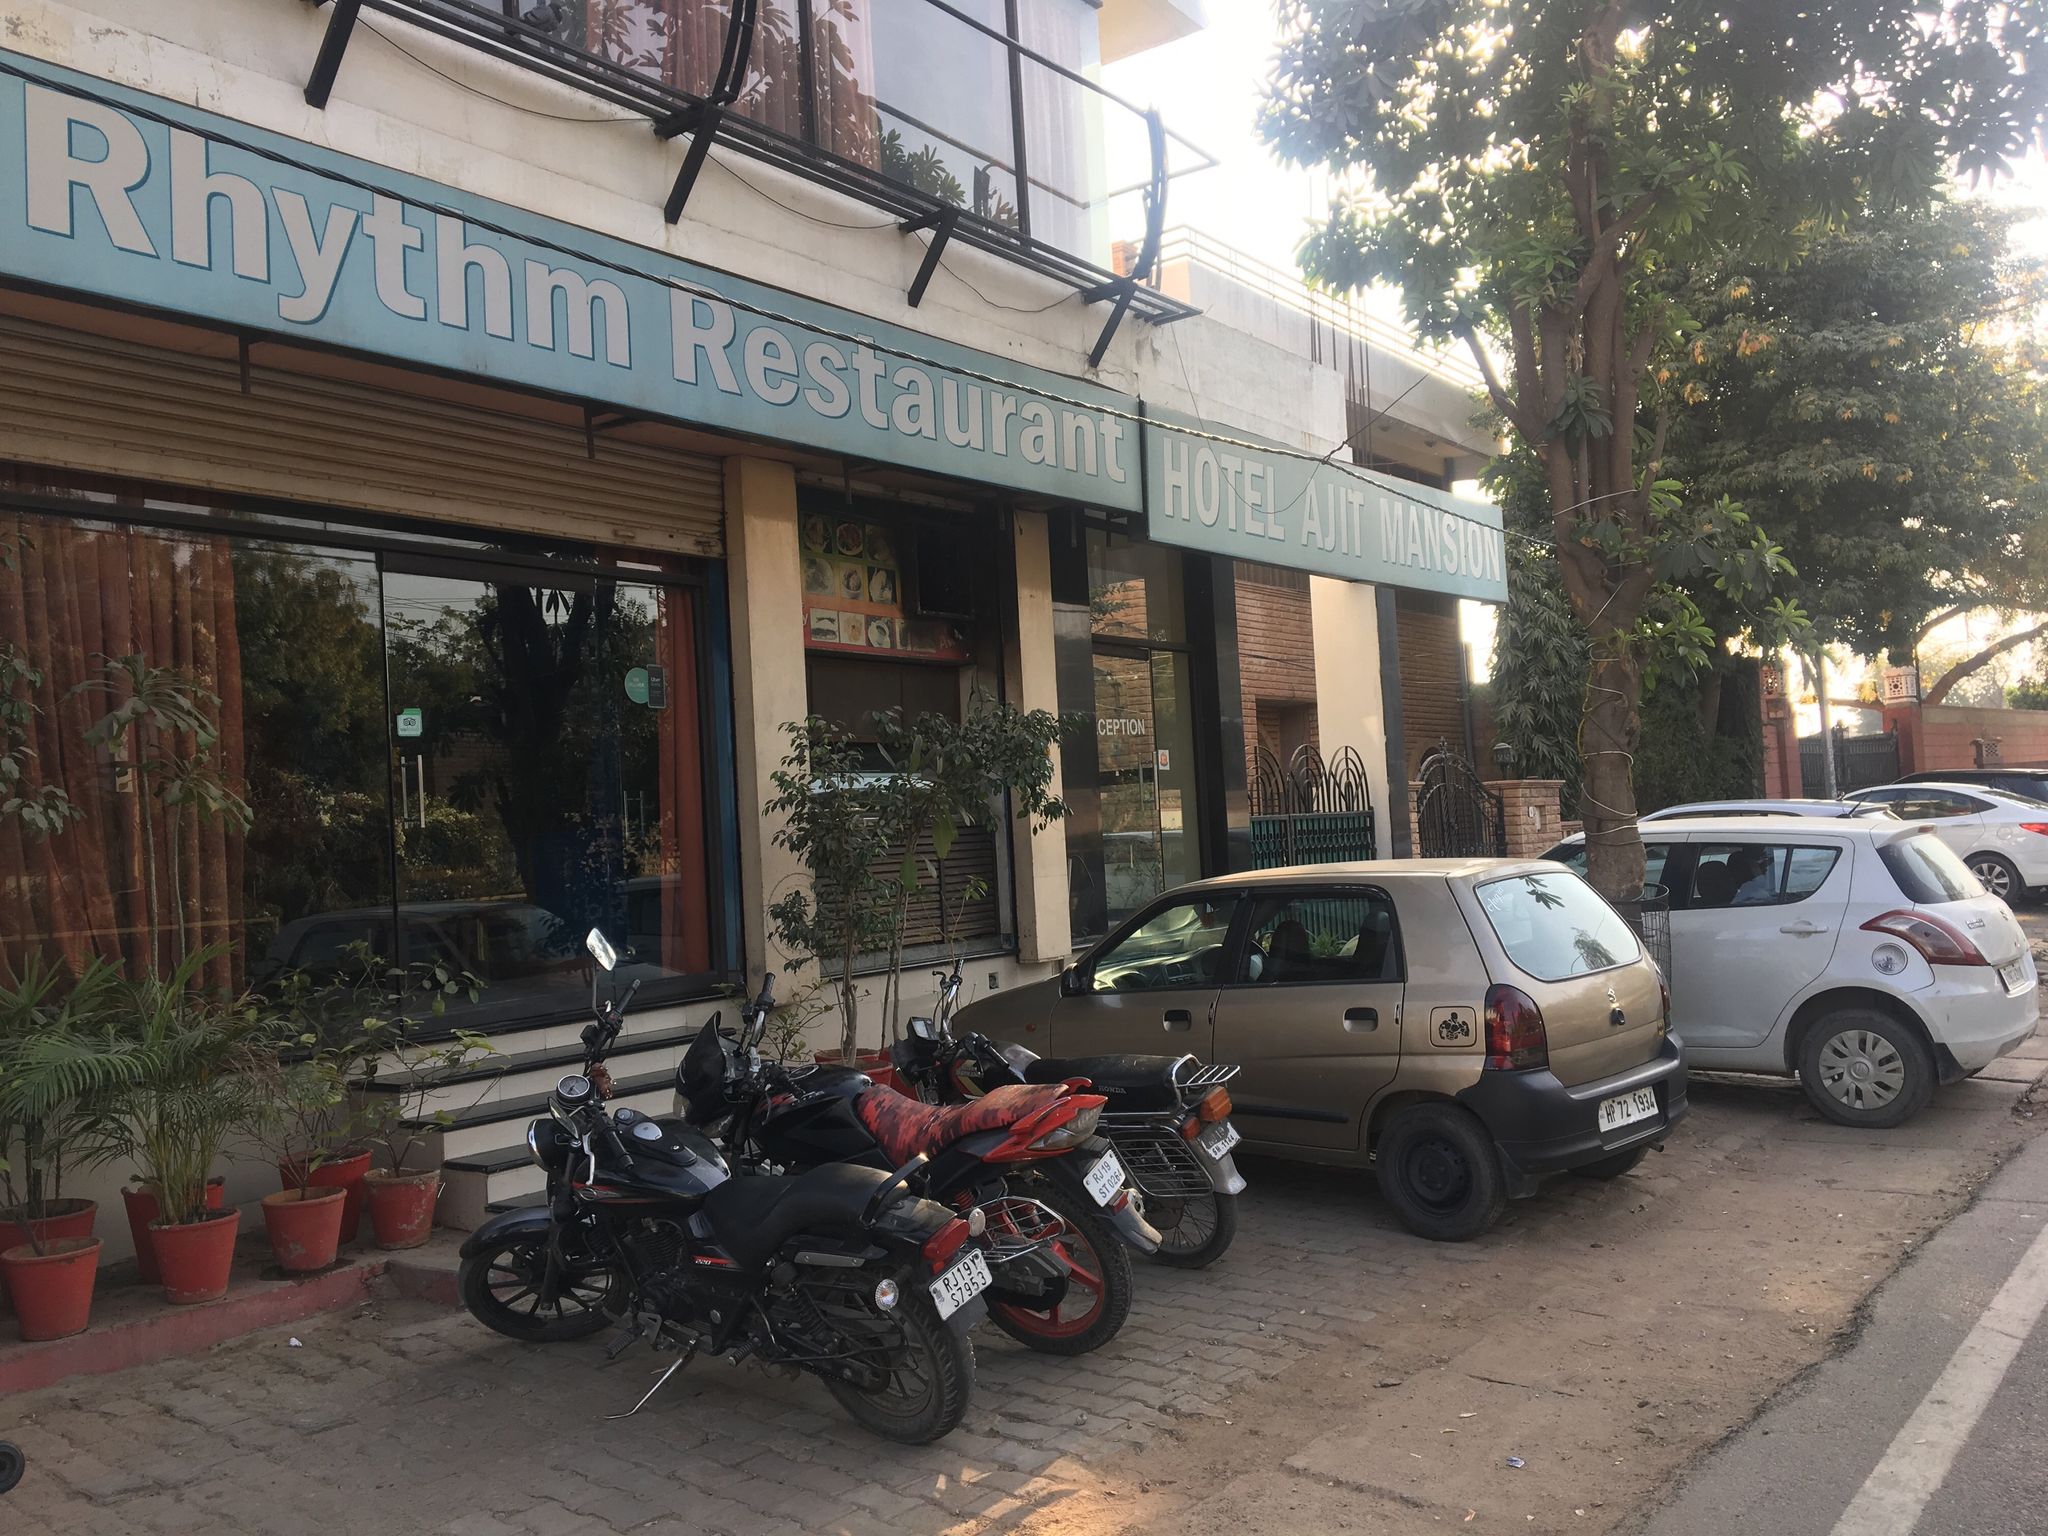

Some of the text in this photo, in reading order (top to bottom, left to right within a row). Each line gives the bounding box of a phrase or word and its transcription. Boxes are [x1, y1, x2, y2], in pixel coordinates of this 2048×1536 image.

[24, 82, 1127, 483] Rhythm Restaurant
[1163, 437, 1501, 582] HOTEL AJIT MANSION
[950, 1270, 987, 1308] S7953
